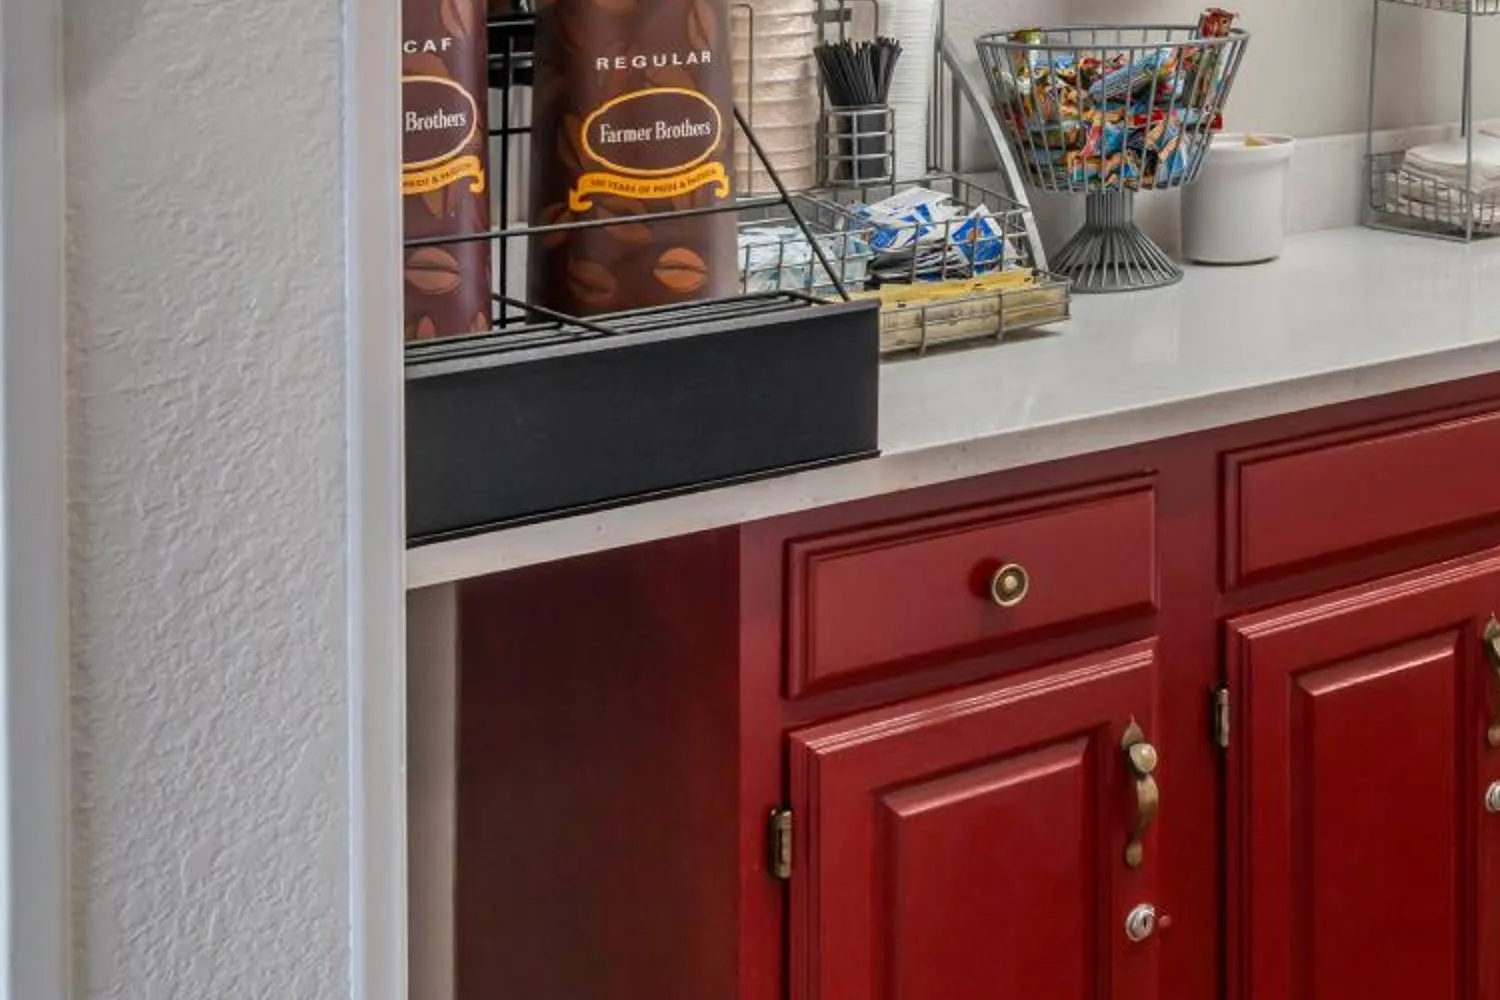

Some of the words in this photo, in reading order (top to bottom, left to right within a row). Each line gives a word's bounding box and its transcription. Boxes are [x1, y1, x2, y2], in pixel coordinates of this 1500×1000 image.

[403, 37, 453, 53] CAF
[596, 50, 712, 71] REGULAR
[405, 108, 467, 131] Brothers
[600, 122, 652, 144] Farmer
[655, 117, 711, 140] Brothers
